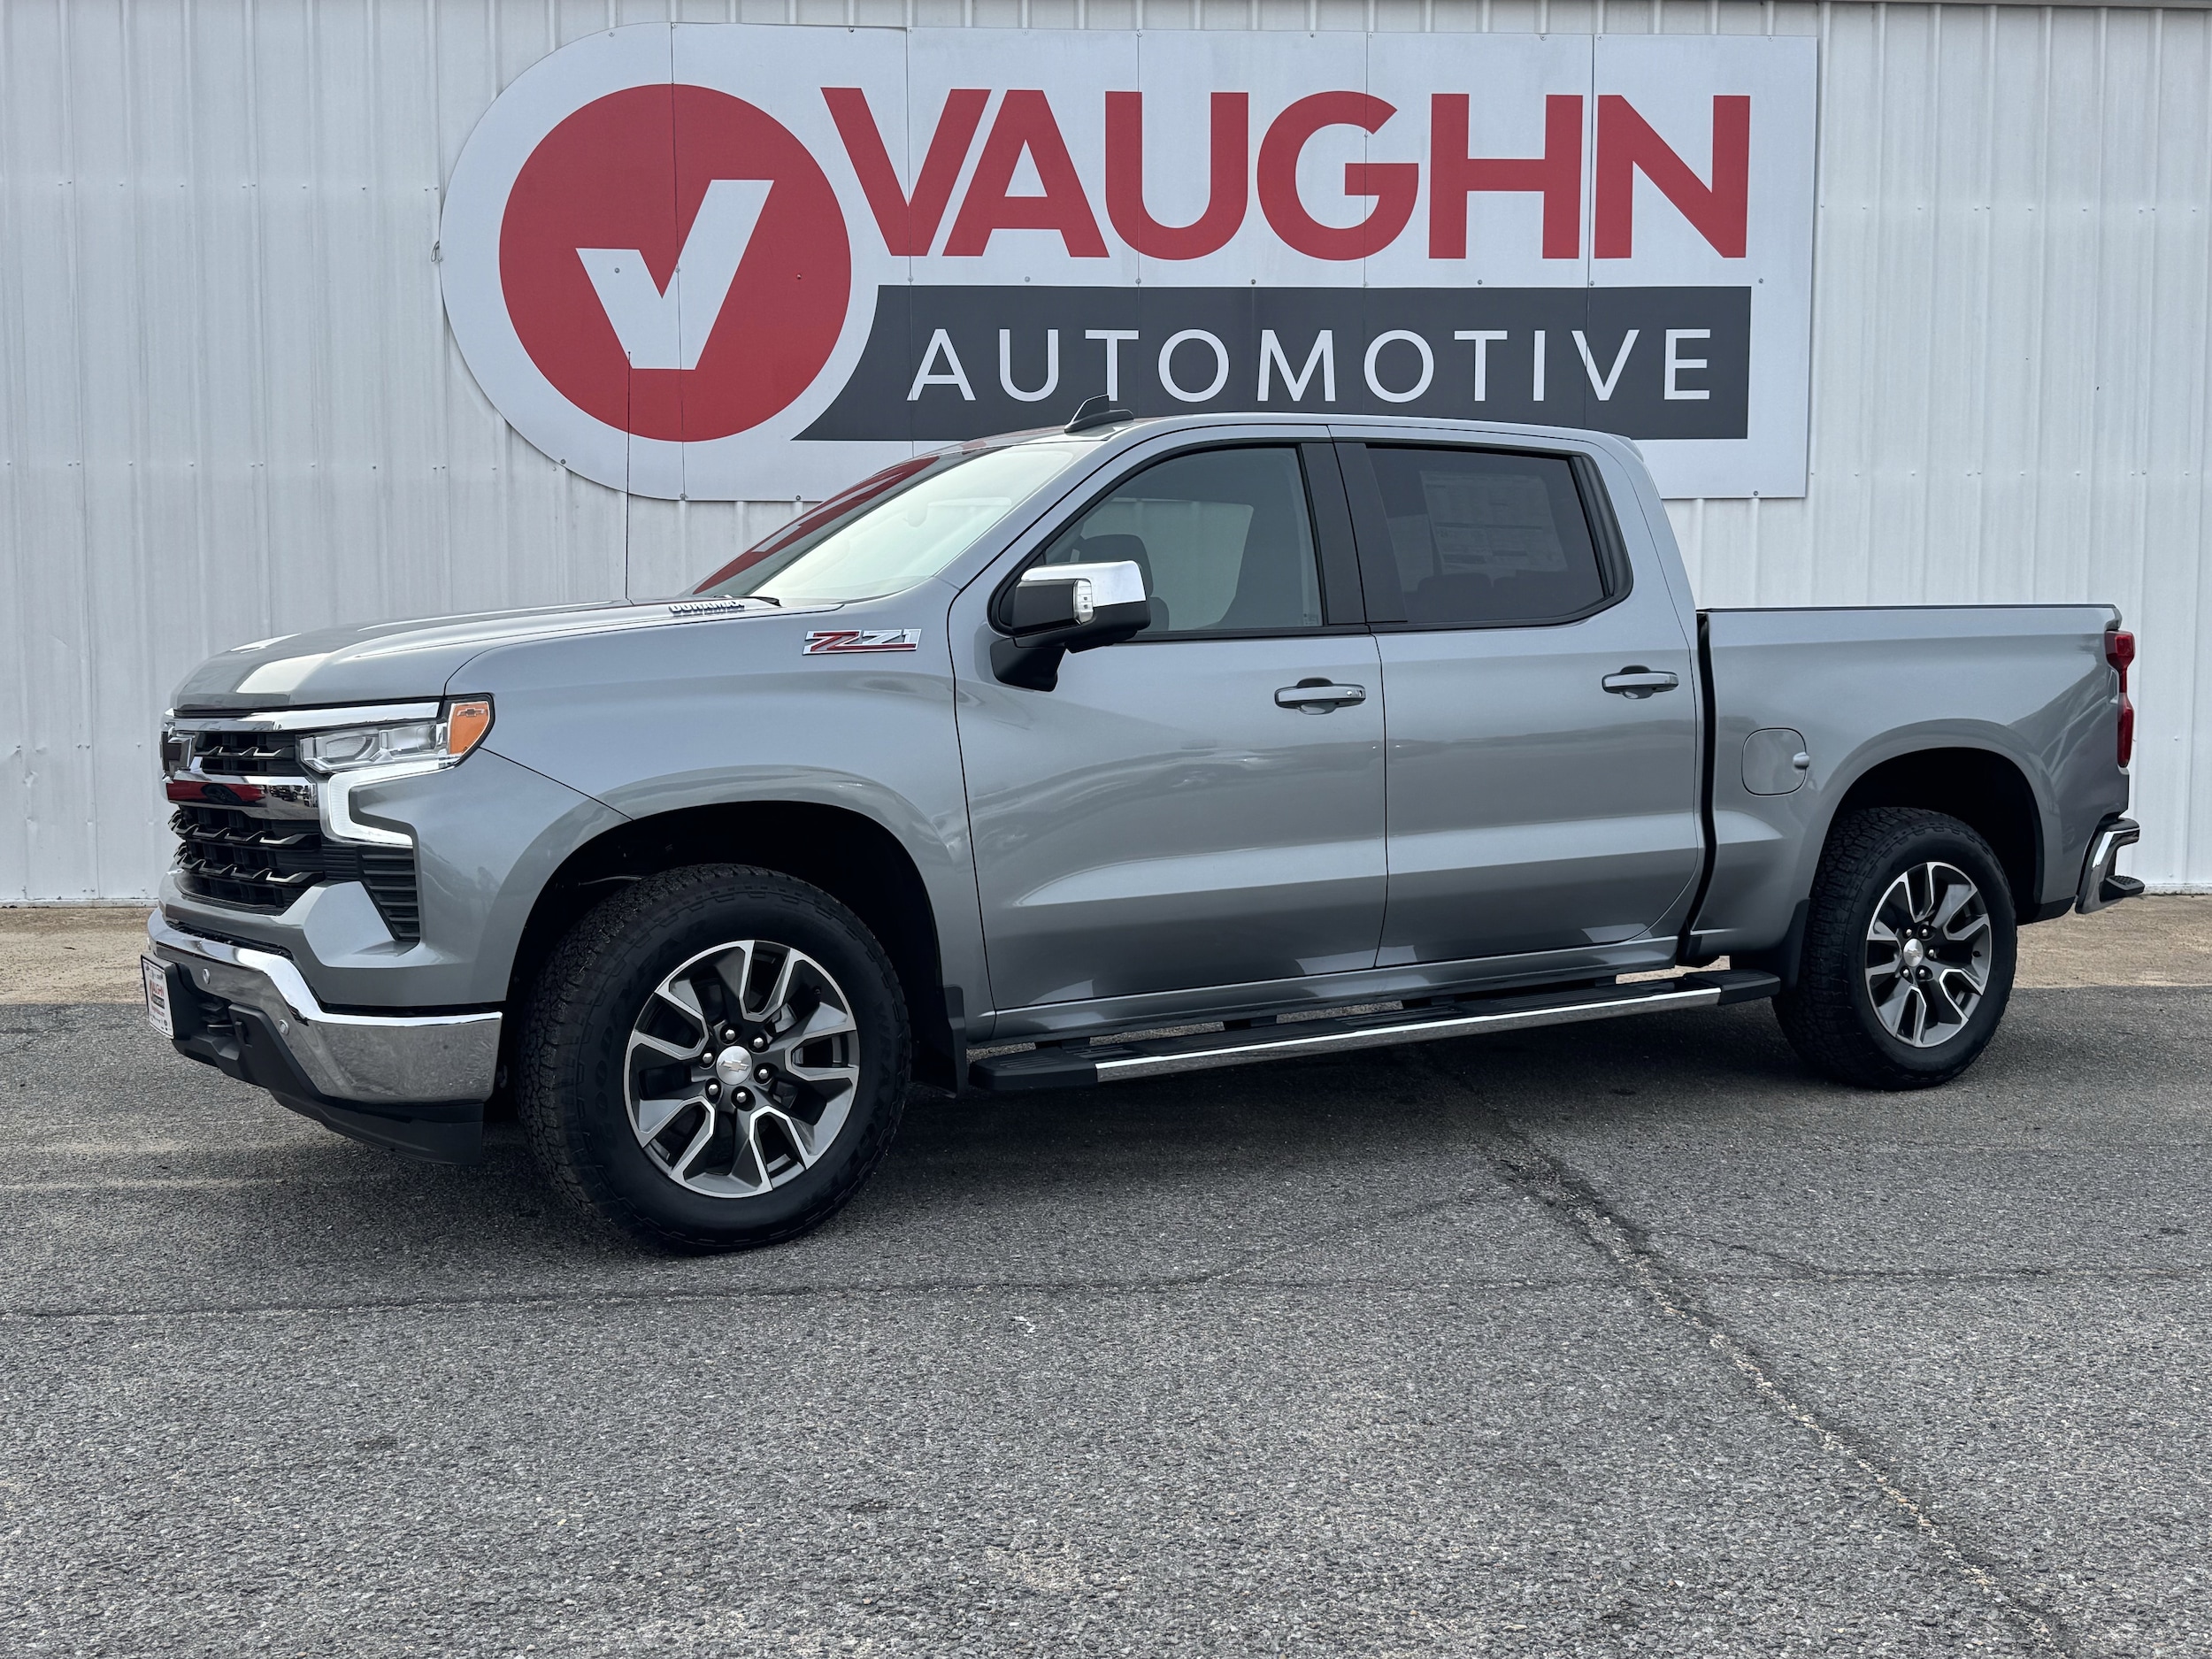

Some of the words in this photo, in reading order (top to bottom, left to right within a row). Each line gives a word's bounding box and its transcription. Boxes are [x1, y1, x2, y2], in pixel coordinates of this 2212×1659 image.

[821, 87, 1750, 260] VAUGHN
[907, 327, 1711, 403] AUTOMOTIVE
[668, 601, 745, 617] DURAMAX
[803, 628, 922, 656] Z71
